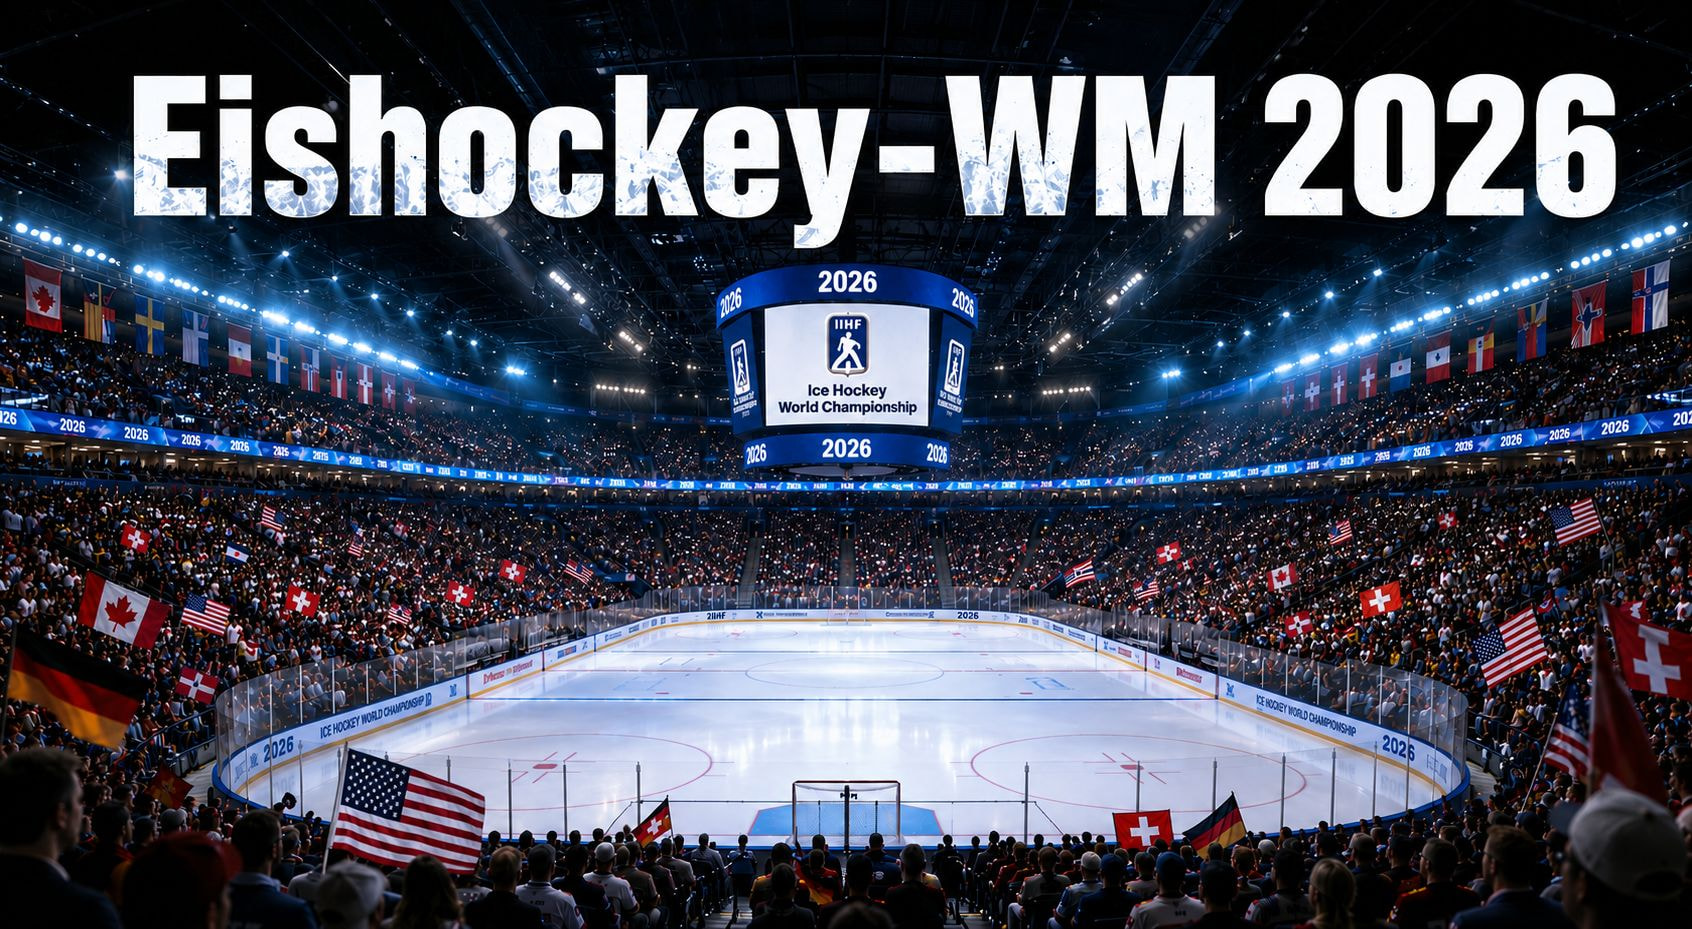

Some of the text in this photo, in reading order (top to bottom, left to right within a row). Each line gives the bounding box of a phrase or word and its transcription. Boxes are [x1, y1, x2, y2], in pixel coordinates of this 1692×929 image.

[818, 270, 877, 293] 2026
[720, 287, 742, 318] 2026
[952, 288, 974, 318] 2026
[835, 319, 861, 330] IIHF
[808, 384, 887, 399] Ice Hockey
[778, 401, 917, 416] World Championship
[60, 418, 86, 433] 2026
[1601, 419, 1630, 435] 2026
[124, 426, 149, 441] 2026
[181, 433, 201, 447] 2026
[1500, 433, 1522, 447] 2026
[1549, 428, 1570, 441] 2026
[230, 440, 250, 452] 2026
[746, 443, 767, 464] 2026
[822, 438, 871, 458] 2026
[926, 443, 947, 464] 2026
[1454, 440, 1473, 452] 2026
[957, 611, 979, 620] 2026
[320, 724, 332, 739] ICE
[333, 715, 360, 735] HOCKEY
[361, 708, 383, 725] WORLD
[383, 695, 424, 717] CHAMPIONSHIP
[1256, 694, 1357, 737] ICE HOCKEY WORLD CHAMPIONSHIP
[264, 736, 293, 763] 2026
[1382, 734, 1415, 761] 2026
